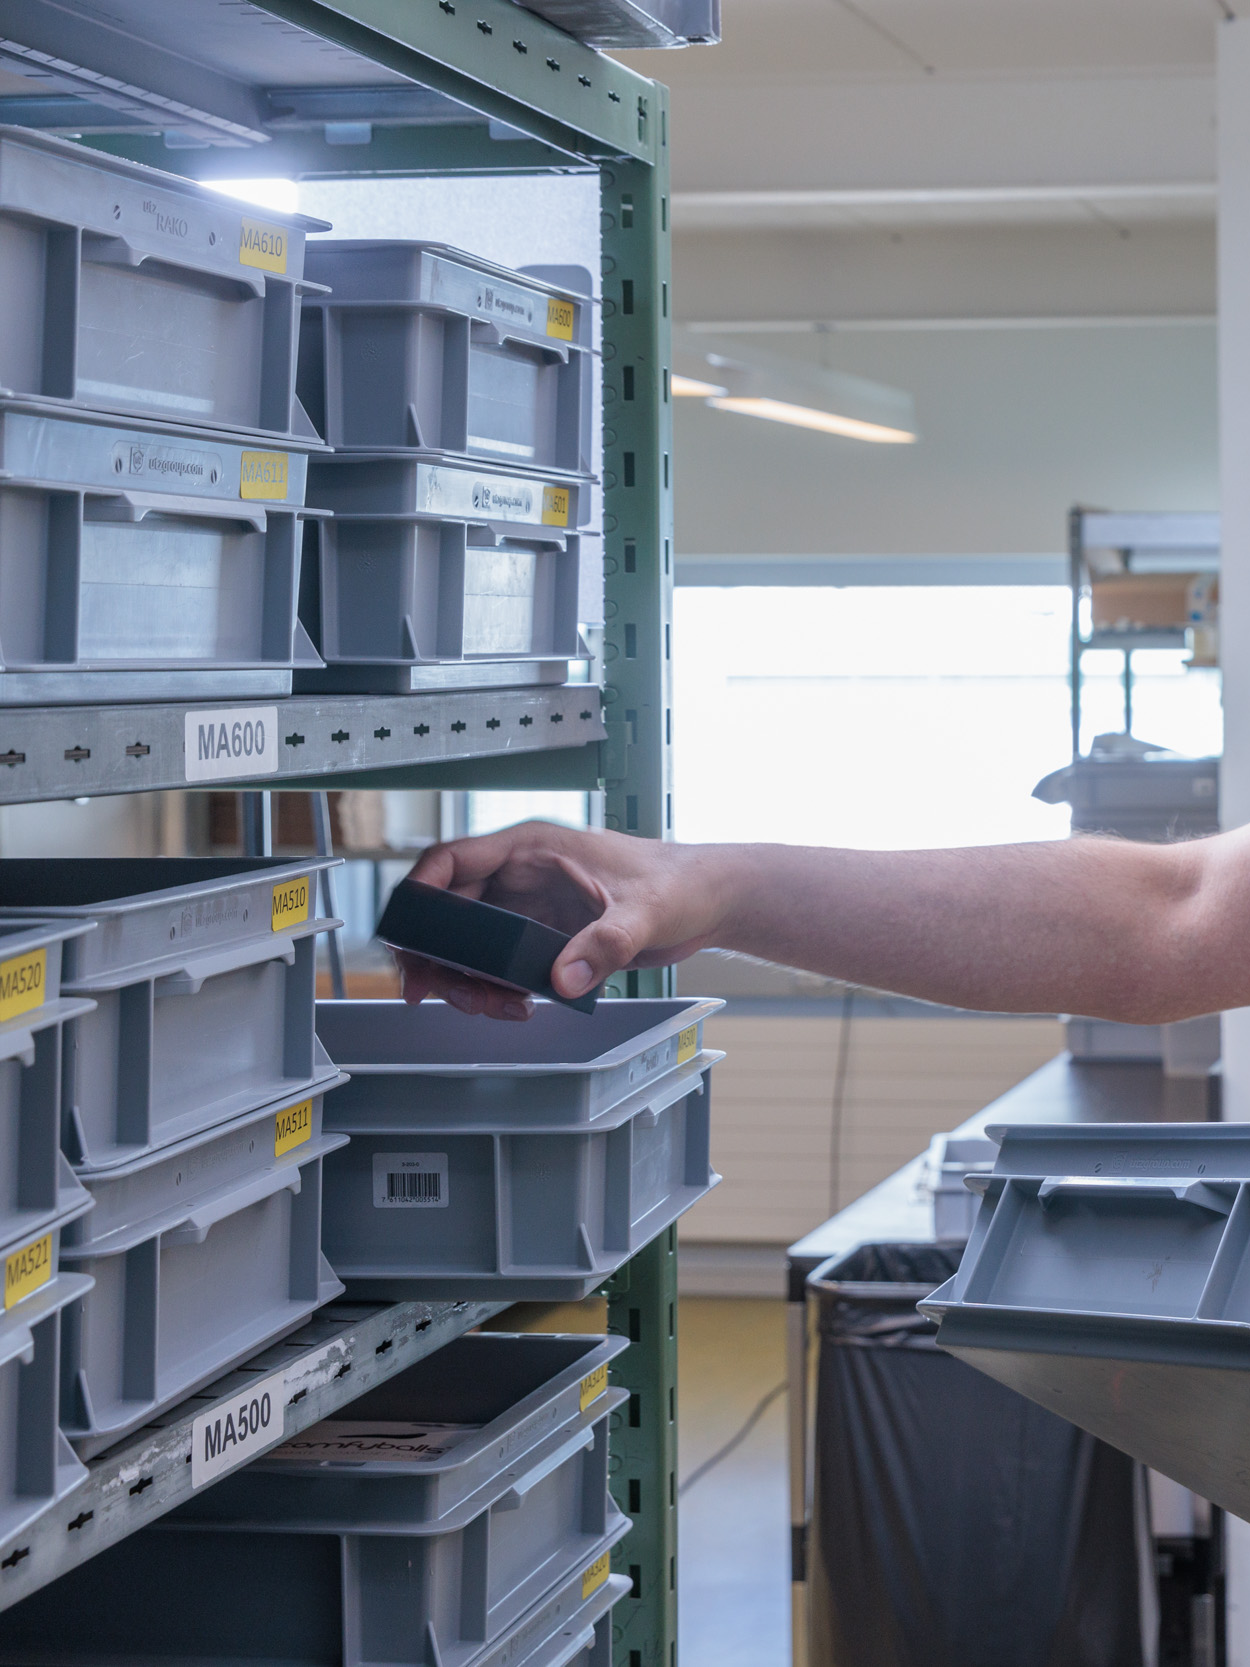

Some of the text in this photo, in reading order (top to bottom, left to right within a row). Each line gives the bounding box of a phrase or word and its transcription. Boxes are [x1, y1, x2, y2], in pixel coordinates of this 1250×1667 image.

[156, 212, 188, 238] RAKO
[240, 226, 283, 257] MA610
[547, 305, 571, 328] MA600
[148, 457, 204, 477] utzgroup.com
[242, 461, 285, 484] MA611
[198, 720, 265, 761] MA600
[272, 886, 306, 916] MA510
[0, 962, 42, 1000] MA520
[679, 1027, 696, 1049] MA500
[275, 1106, 308, 1143] MA511
[7, 1238, 48, 1289] MA521
[205, 1392, 271, 1462] MA500
[277, 1441, 445, 1454] comfyballs
